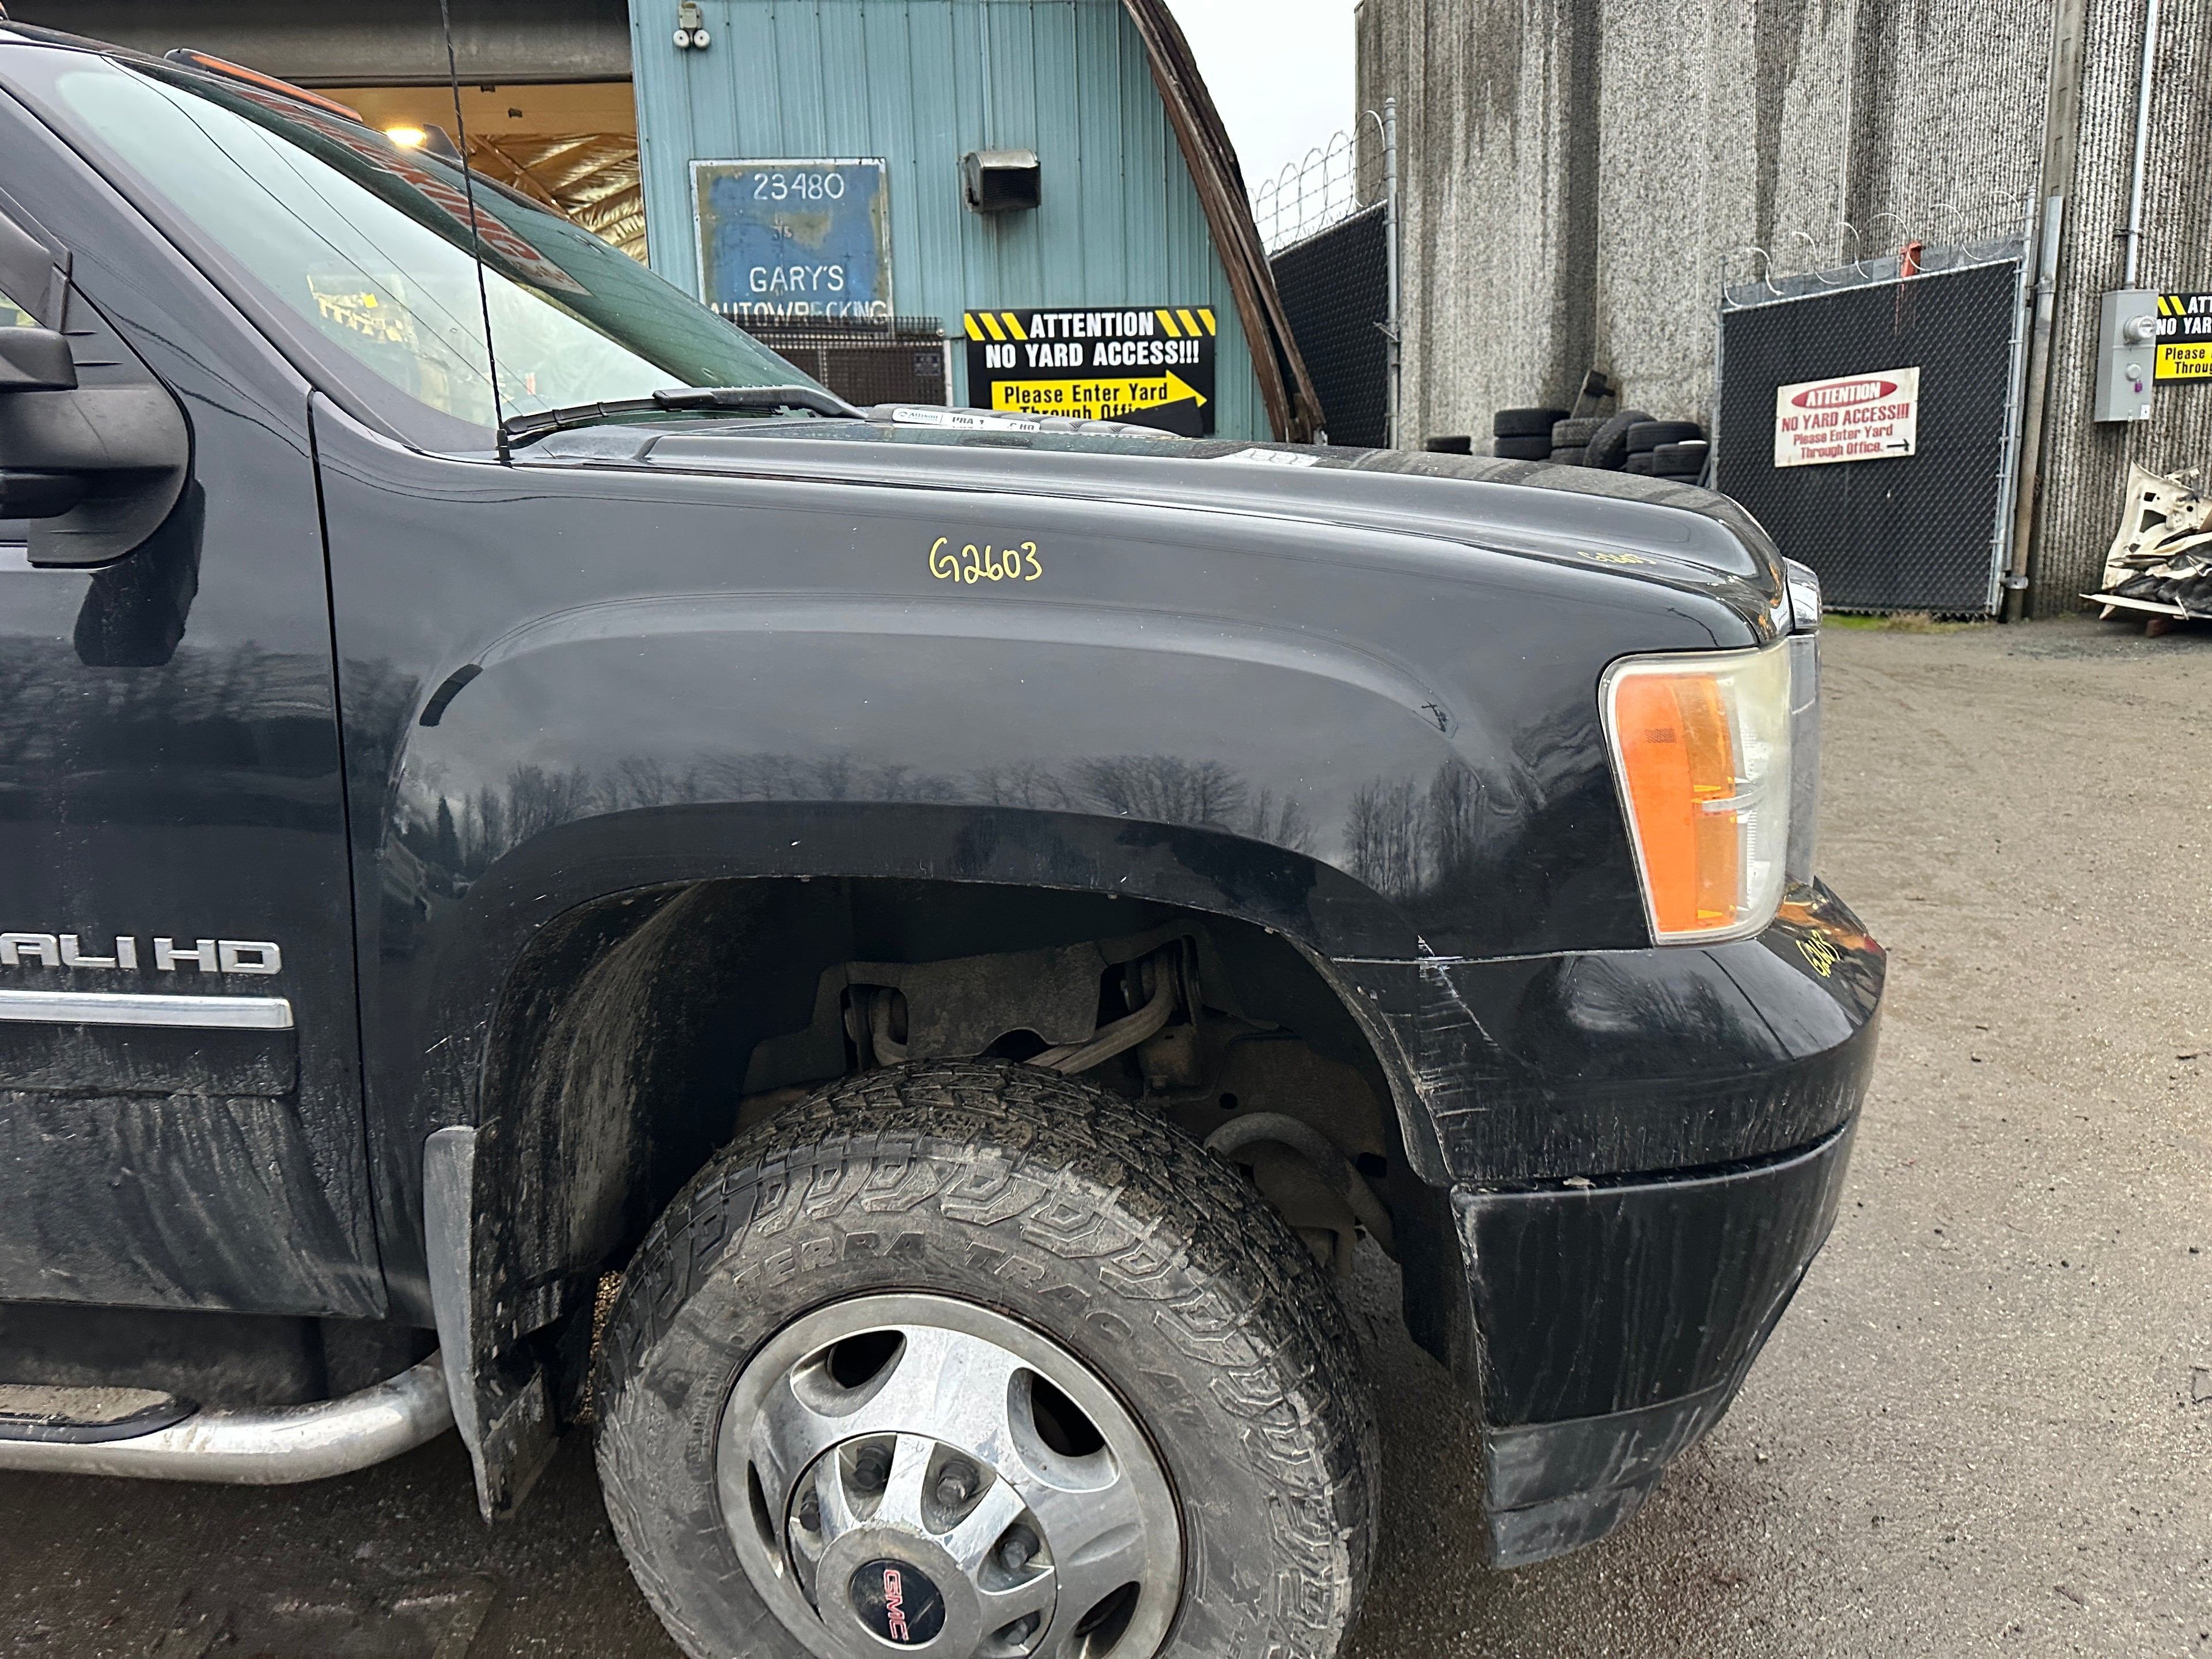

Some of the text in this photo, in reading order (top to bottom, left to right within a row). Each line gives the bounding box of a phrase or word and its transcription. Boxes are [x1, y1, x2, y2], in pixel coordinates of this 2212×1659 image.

[753, 172, 844, 200] 23480
[749, 264, 844, 293] GARY'S
[2187, 296, 2212, 314] ATT
[1029, 311, 1154, 339] ATTENTION
[2156, 316, 2212, 336] NO YAR
[986, 340, 1199, 369] NO YARD ACCESS!!!
[2165, 347, 2206, 361] Please
[1005, 381, 1168, 404] Please Enter Yard
[1805, 381, 1881, 407] ATTENTION
[1781, 403, 1910, 432] NO YARD ACCESS!!!
[1793, 423, 1893, 446] Please Enter Yard
[1800, 445, 1844, 460] Through
[929, 537, 1043, 584] G2603
[153, 937, 282, 975] HD
[883, 1569, 910, 1641] GMC
